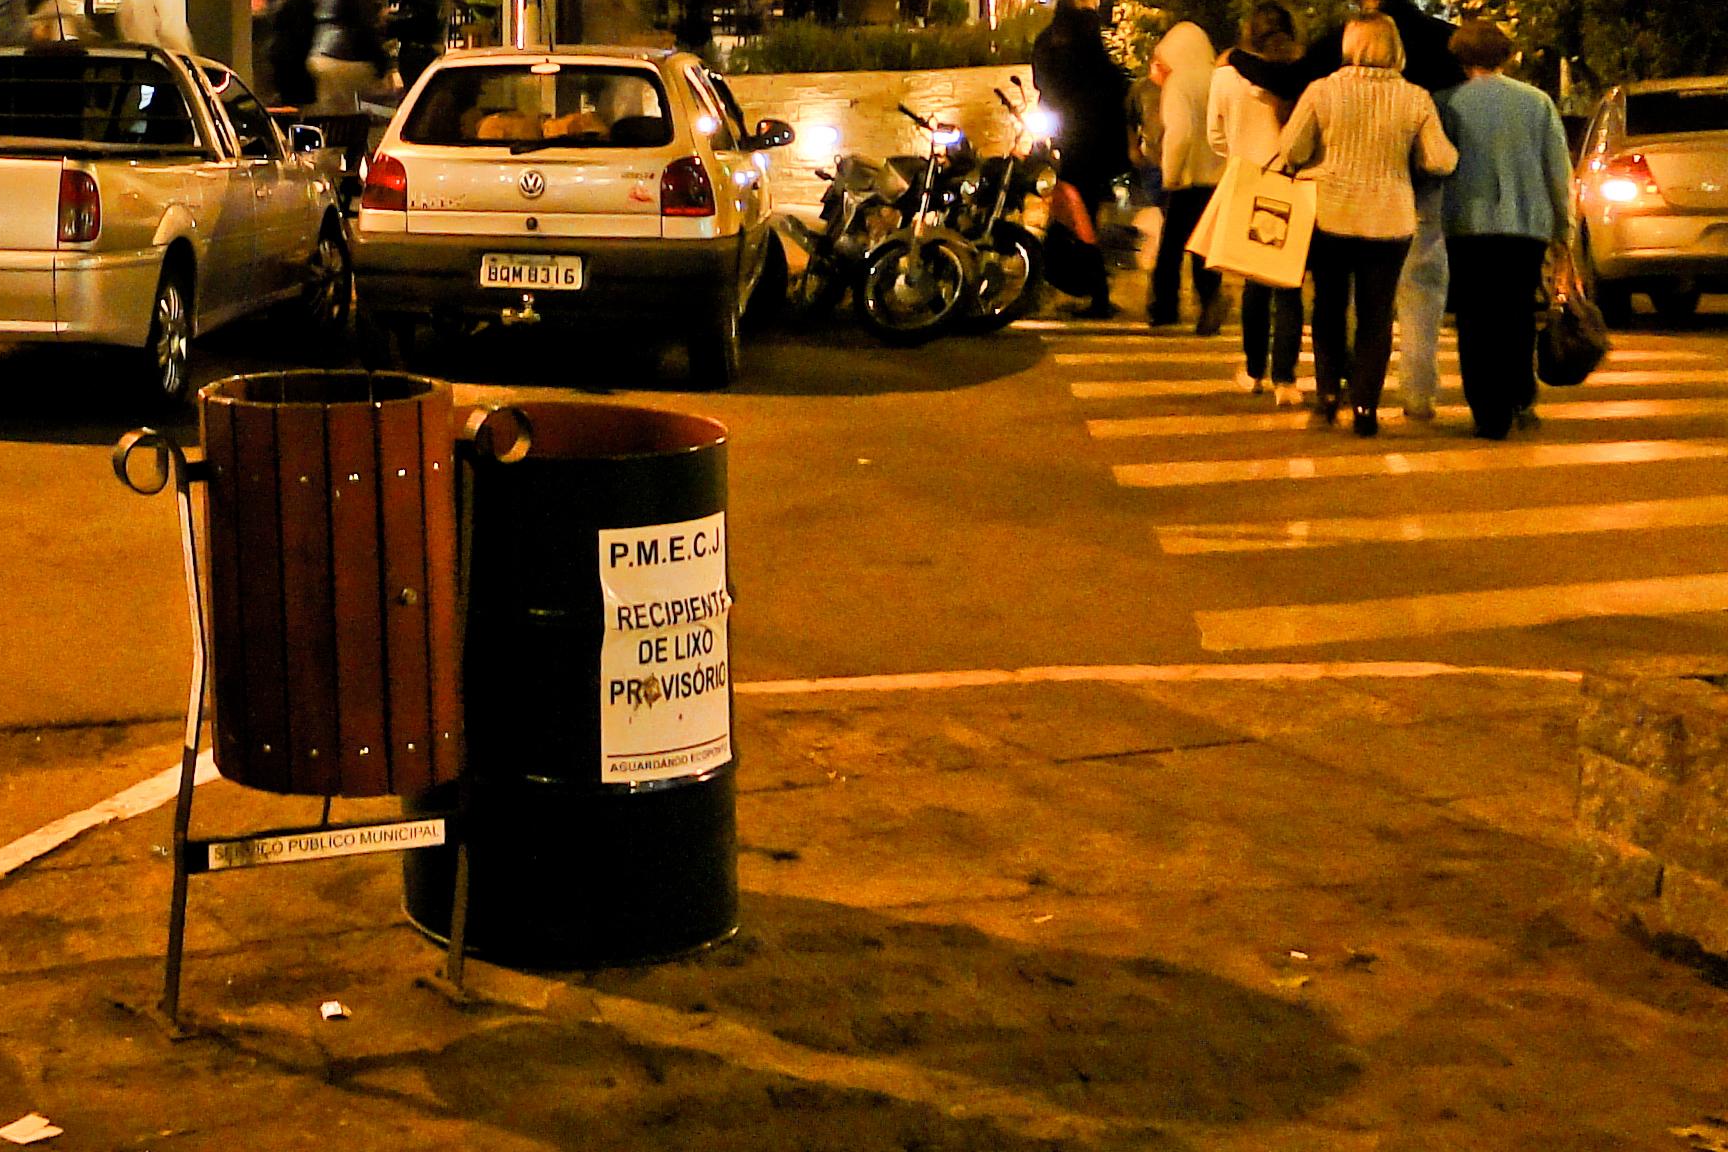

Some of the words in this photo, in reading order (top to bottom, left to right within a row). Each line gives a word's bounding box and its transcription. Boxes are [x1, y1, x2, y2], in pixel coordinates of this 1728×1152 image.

[638, 637, 668, 664] DE
[675, 628, 713, 660] LIXO
[610, 661, 726, 705] PRVISÓRIO
[214, 841, 284, 862] SEIÇO
[360, 826, 440, 845] MUNICIPAL
